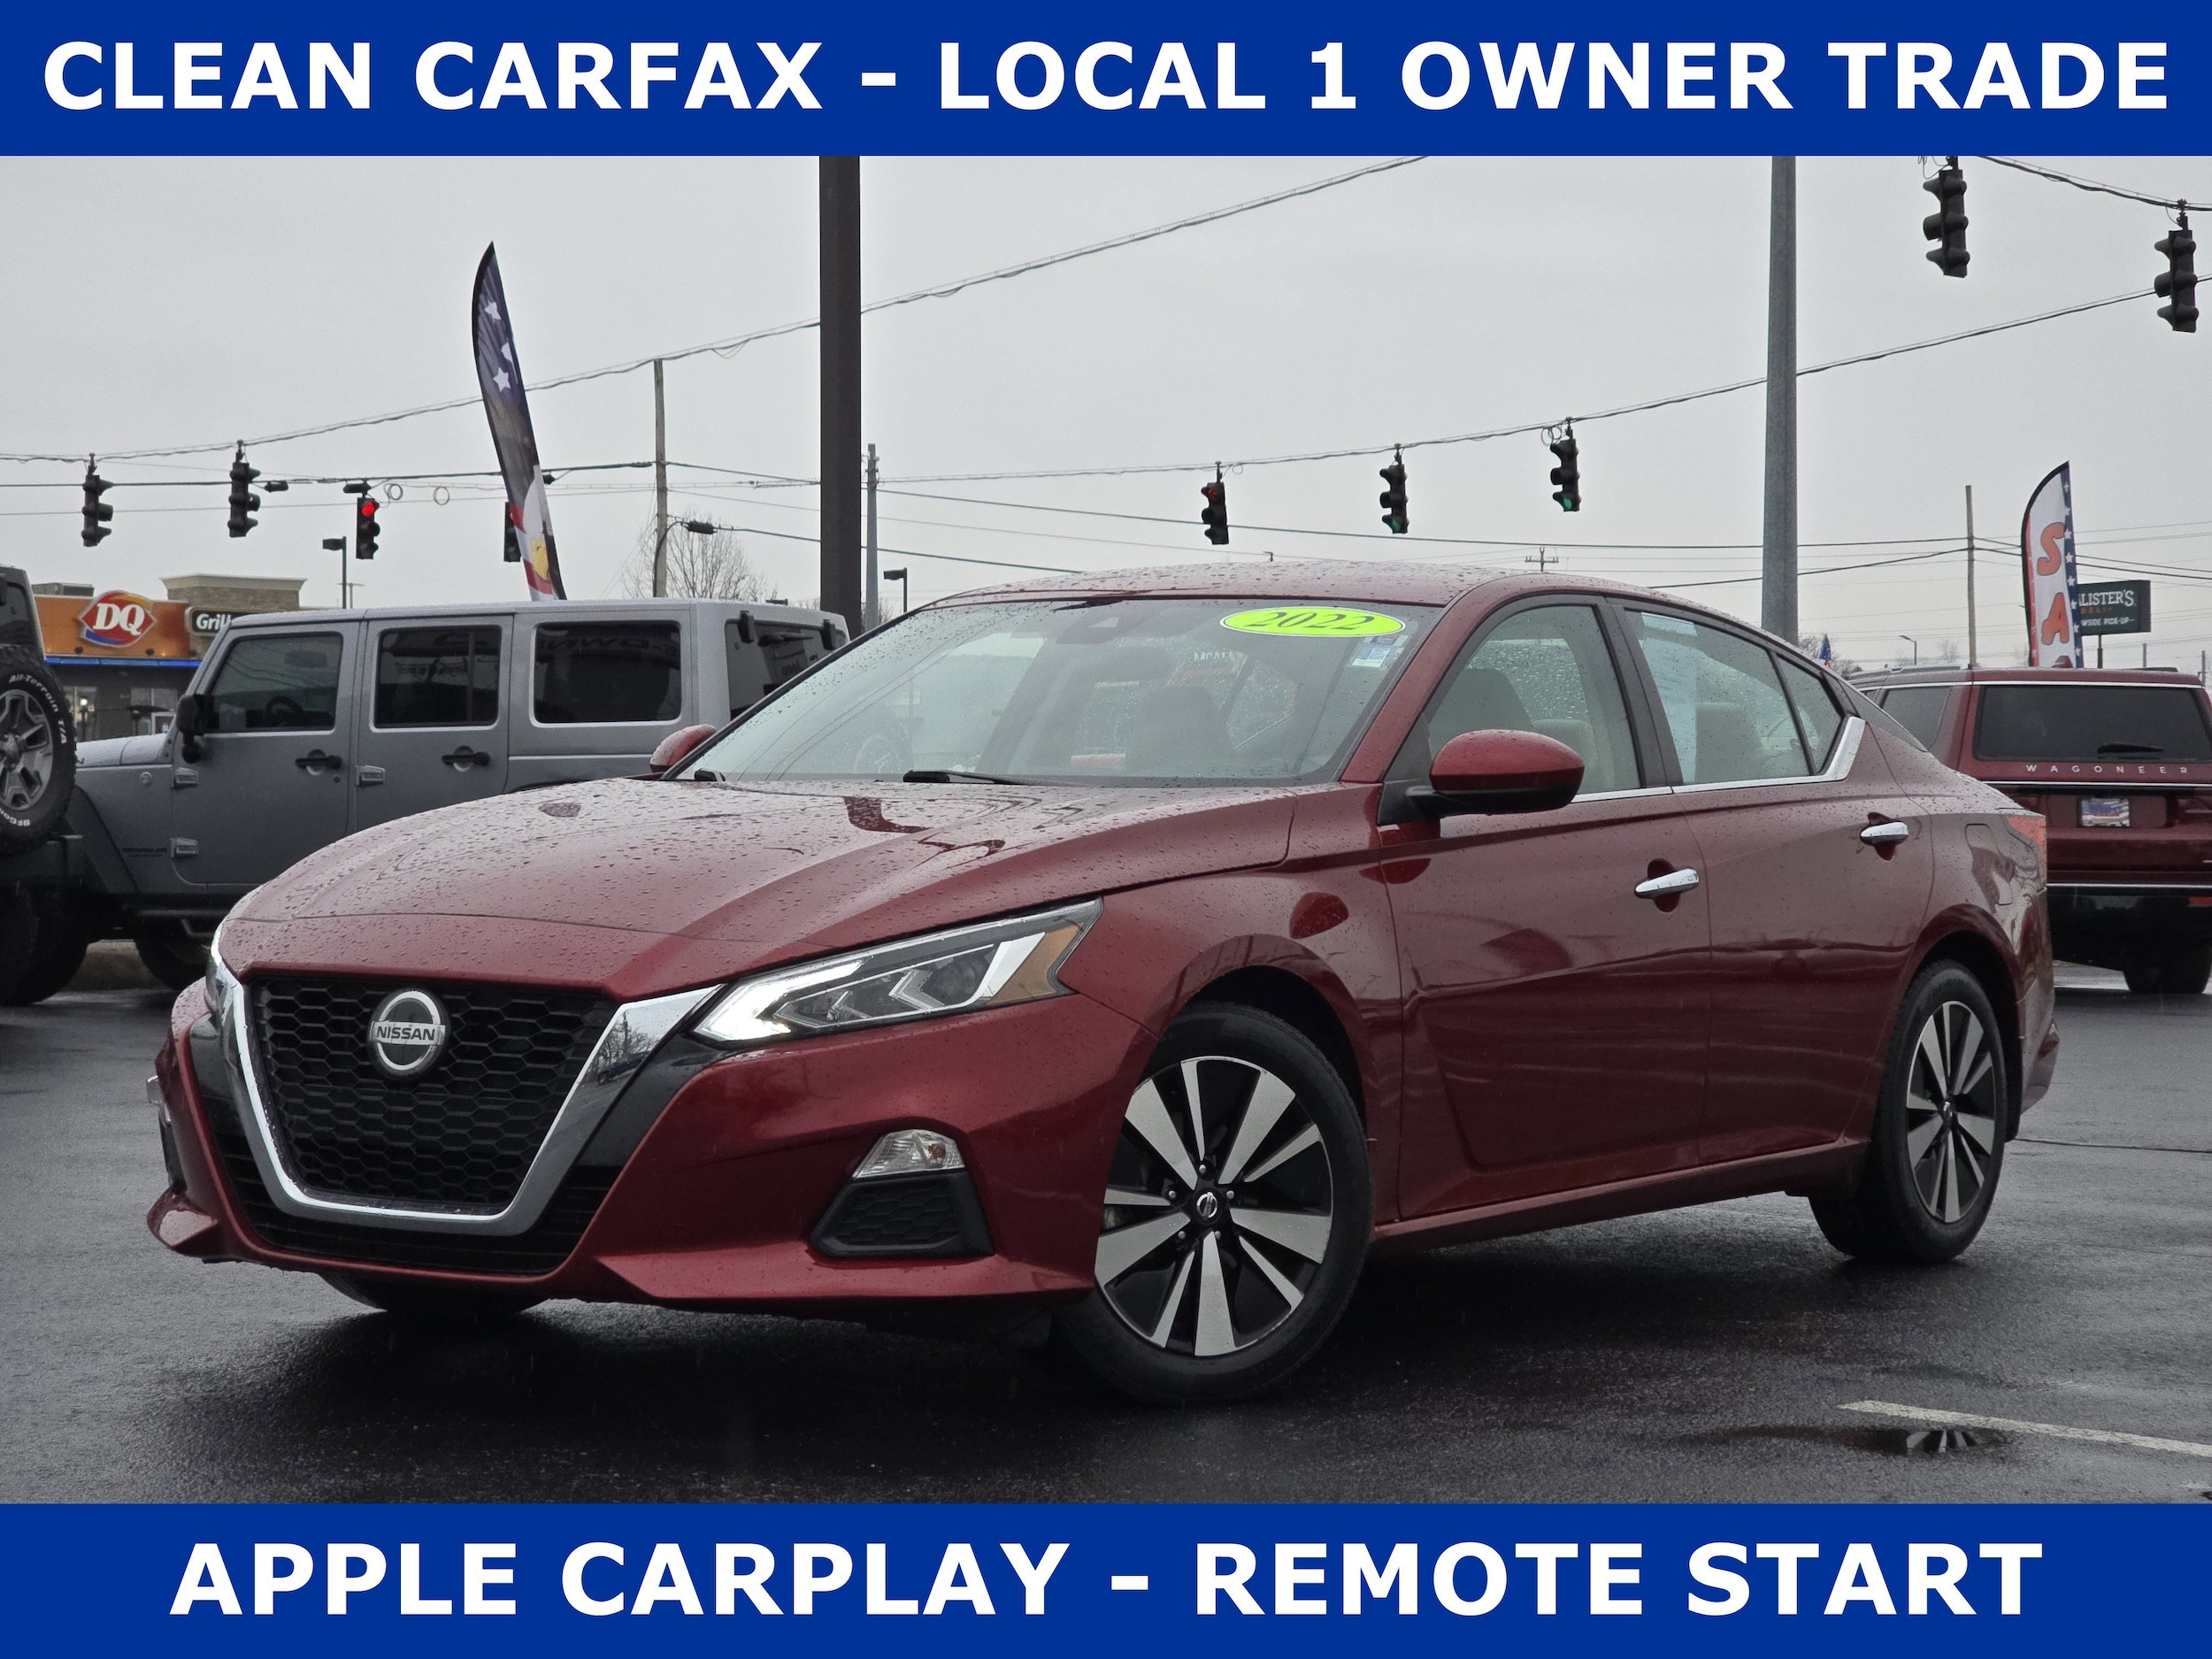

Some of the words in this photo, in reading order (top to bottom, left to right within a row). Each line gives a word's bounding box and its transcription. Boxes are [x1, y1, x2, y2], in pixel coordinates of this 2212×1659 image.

[2037, 522, 2074, 667] SA
[2078, 589, 2134, 607] LISTER'S
[93, 603, 145, 635] DQ
[1243, 611, 1375, 630] 2022
[8, 674, 58, 711] All-Terrain
[58, 720, 67, 745] T/A
[2026, 764, 2187, 775] WAGONEER
[0, 806, 31, 827] BFGoo
[376, 1025, 435, 1041] NISSAN
